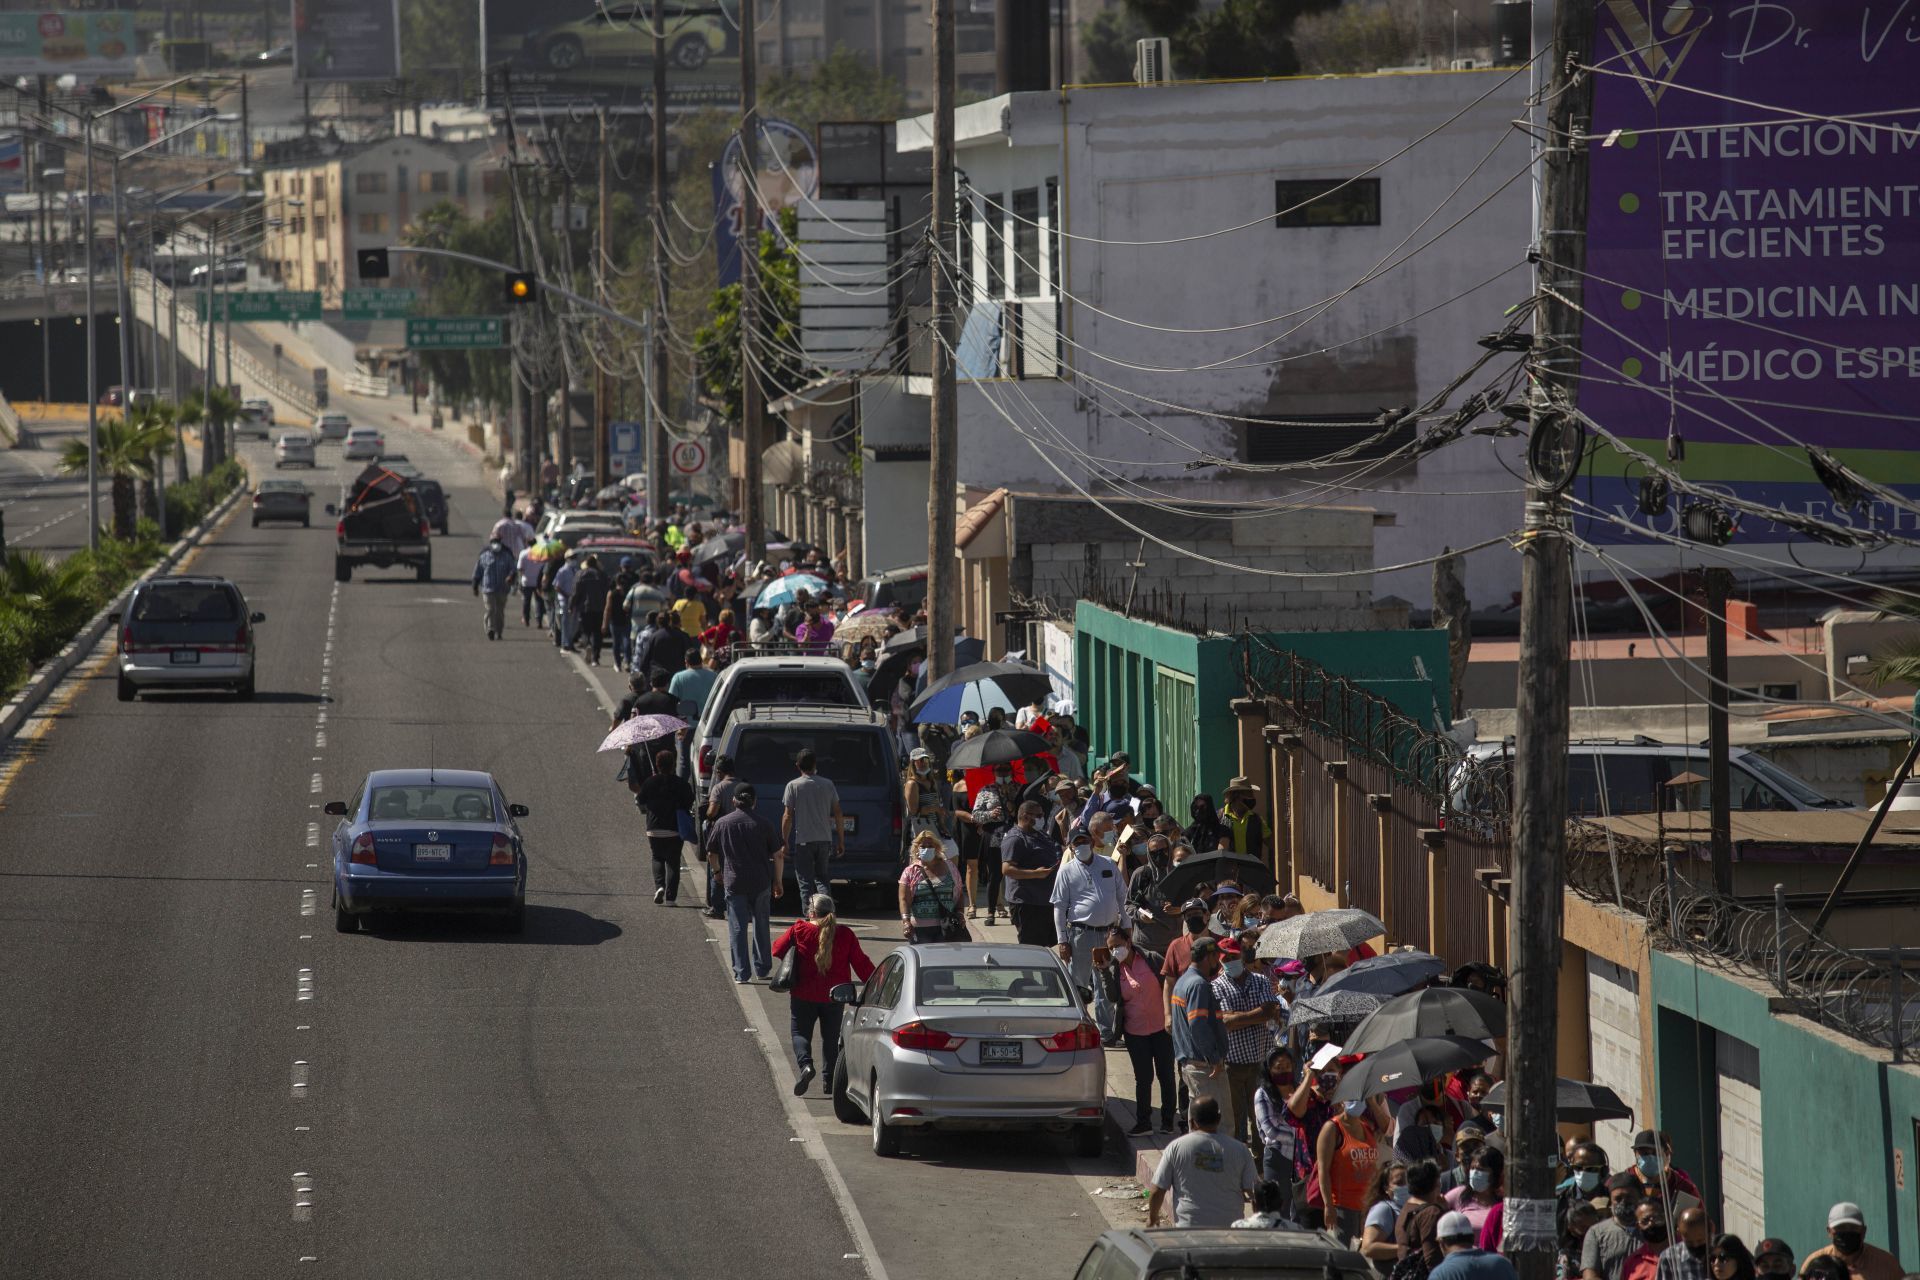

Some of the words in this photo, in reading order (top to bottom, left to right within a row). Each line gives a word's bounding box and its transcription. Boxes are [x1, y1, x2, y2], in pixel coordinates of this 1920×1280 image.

[1721, 0, 1812, 64] Dr.
[1666, 119, 1877, 160] ATENCIÓN
[1658, 185, 1920, 223] TRATAMIENT
[1662, 224, 1886, 260] EFICIENTES
[1663, 284, 1869, 320] MEDICINA
[1659, 341, 1823, 382] MÉDICO
[682, 446, 697, 471] 60
